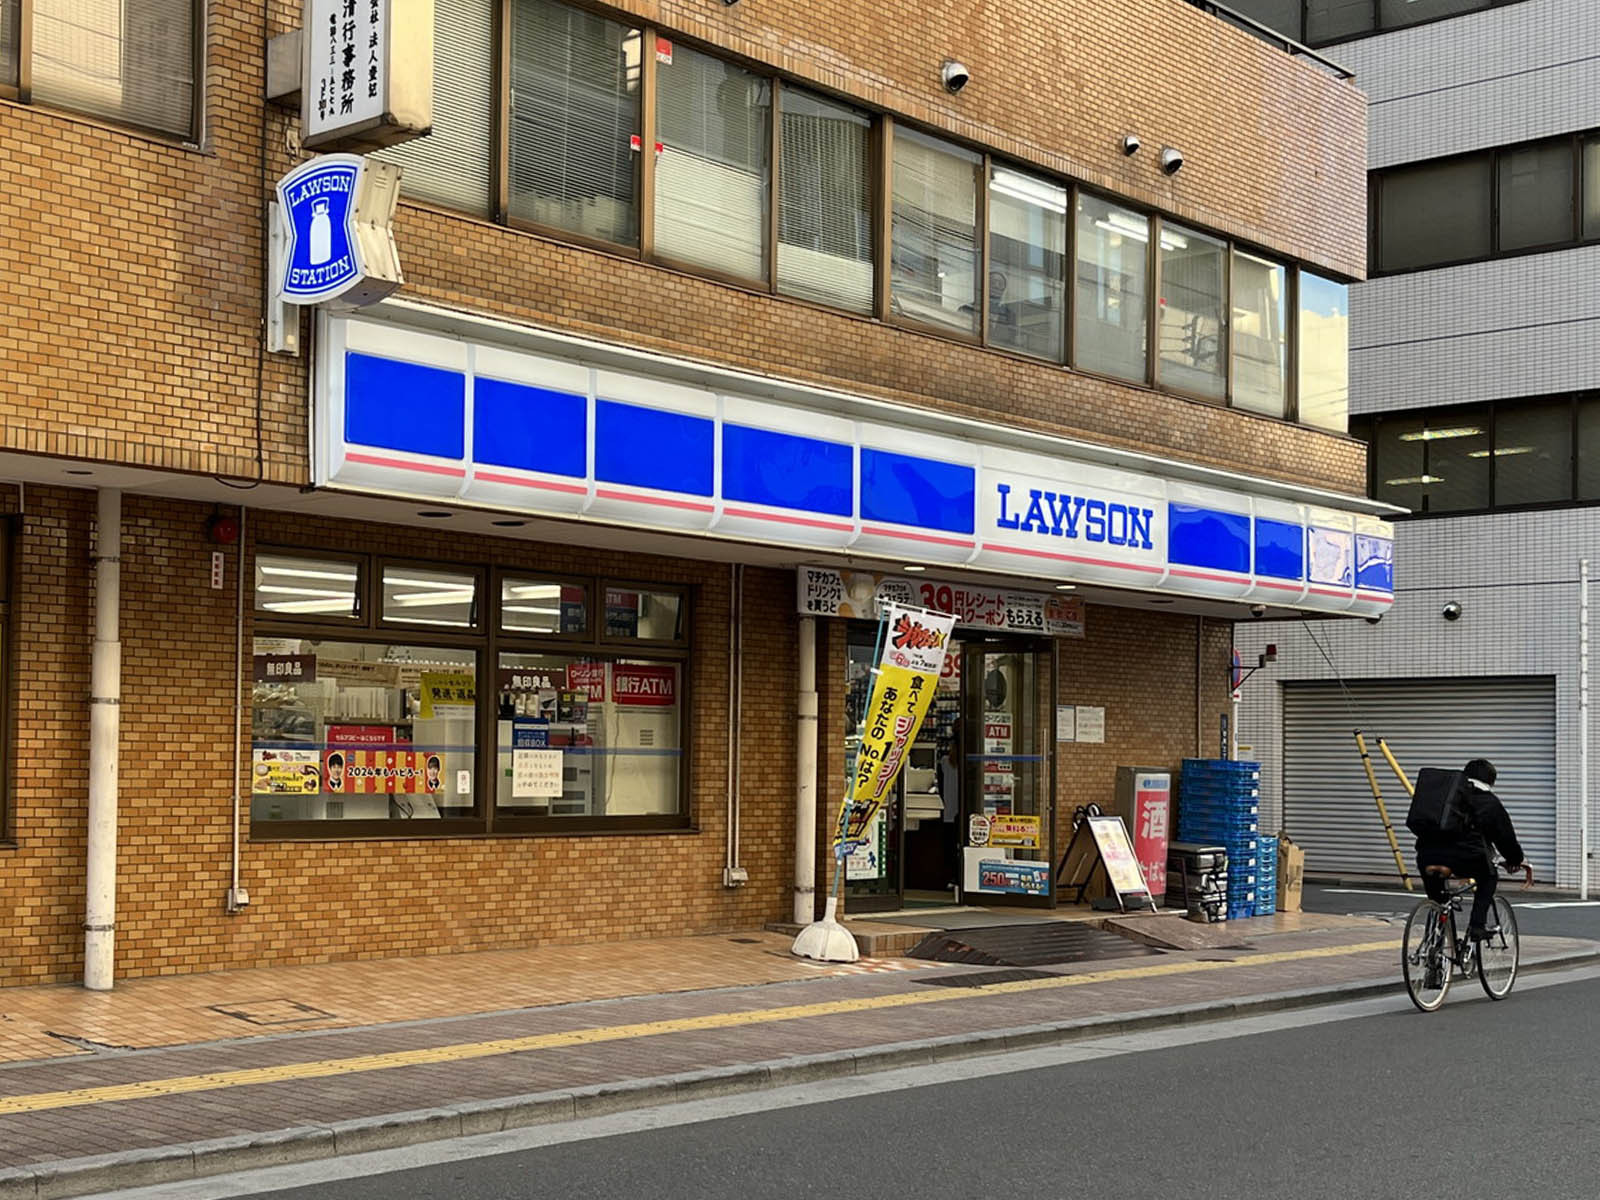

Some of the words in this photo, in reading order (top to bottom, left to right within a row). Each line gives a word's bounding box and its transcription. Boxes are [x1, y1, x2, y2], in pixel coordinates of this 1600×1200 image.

[290, 175, 350, 207] LAWSON
[291, 255, 350, 285] STATION
[997, 483, 1154, 550] LAWSON
[807, 570, 841, 586] マチカフェ
[807, 599, 837, 614] を買うと
[920, 583, 953, 616] 39
[954, 590, 1006, 611] 円レシート
[1006, 607, 1043, 627] もらえる
[266, 661, 302, 676] 無印良品
[512, 675, 552, 690] 無印良品
[615, 675, 673, 696] 銀行ATM
[988, 726, 1008, 738] ATM
[1141, 801, 1168, 839] 酒
